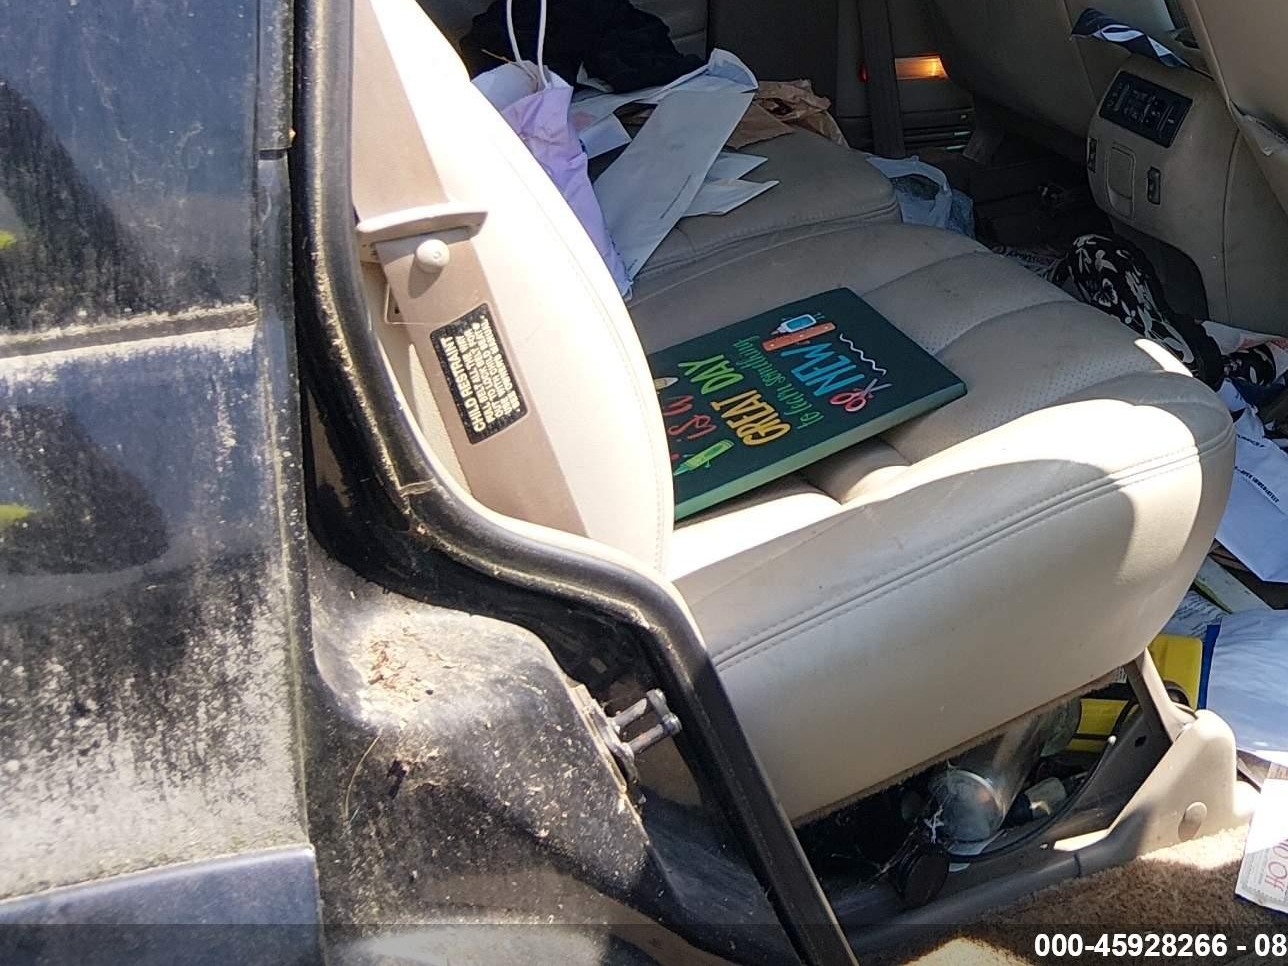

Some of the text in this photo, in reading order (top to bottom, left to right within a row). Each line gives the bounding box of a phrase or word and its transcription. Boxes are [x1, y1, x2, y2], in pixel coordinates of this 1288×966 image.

[440, 336, 486, 432] CHILD RESTRAINT
[473, 381, 488, 404] BELT
[677, 354, 792, 447] GREAT DAY
[731, 334, 824, 430] to learn something
[780, 341, 865, 397] NEW
